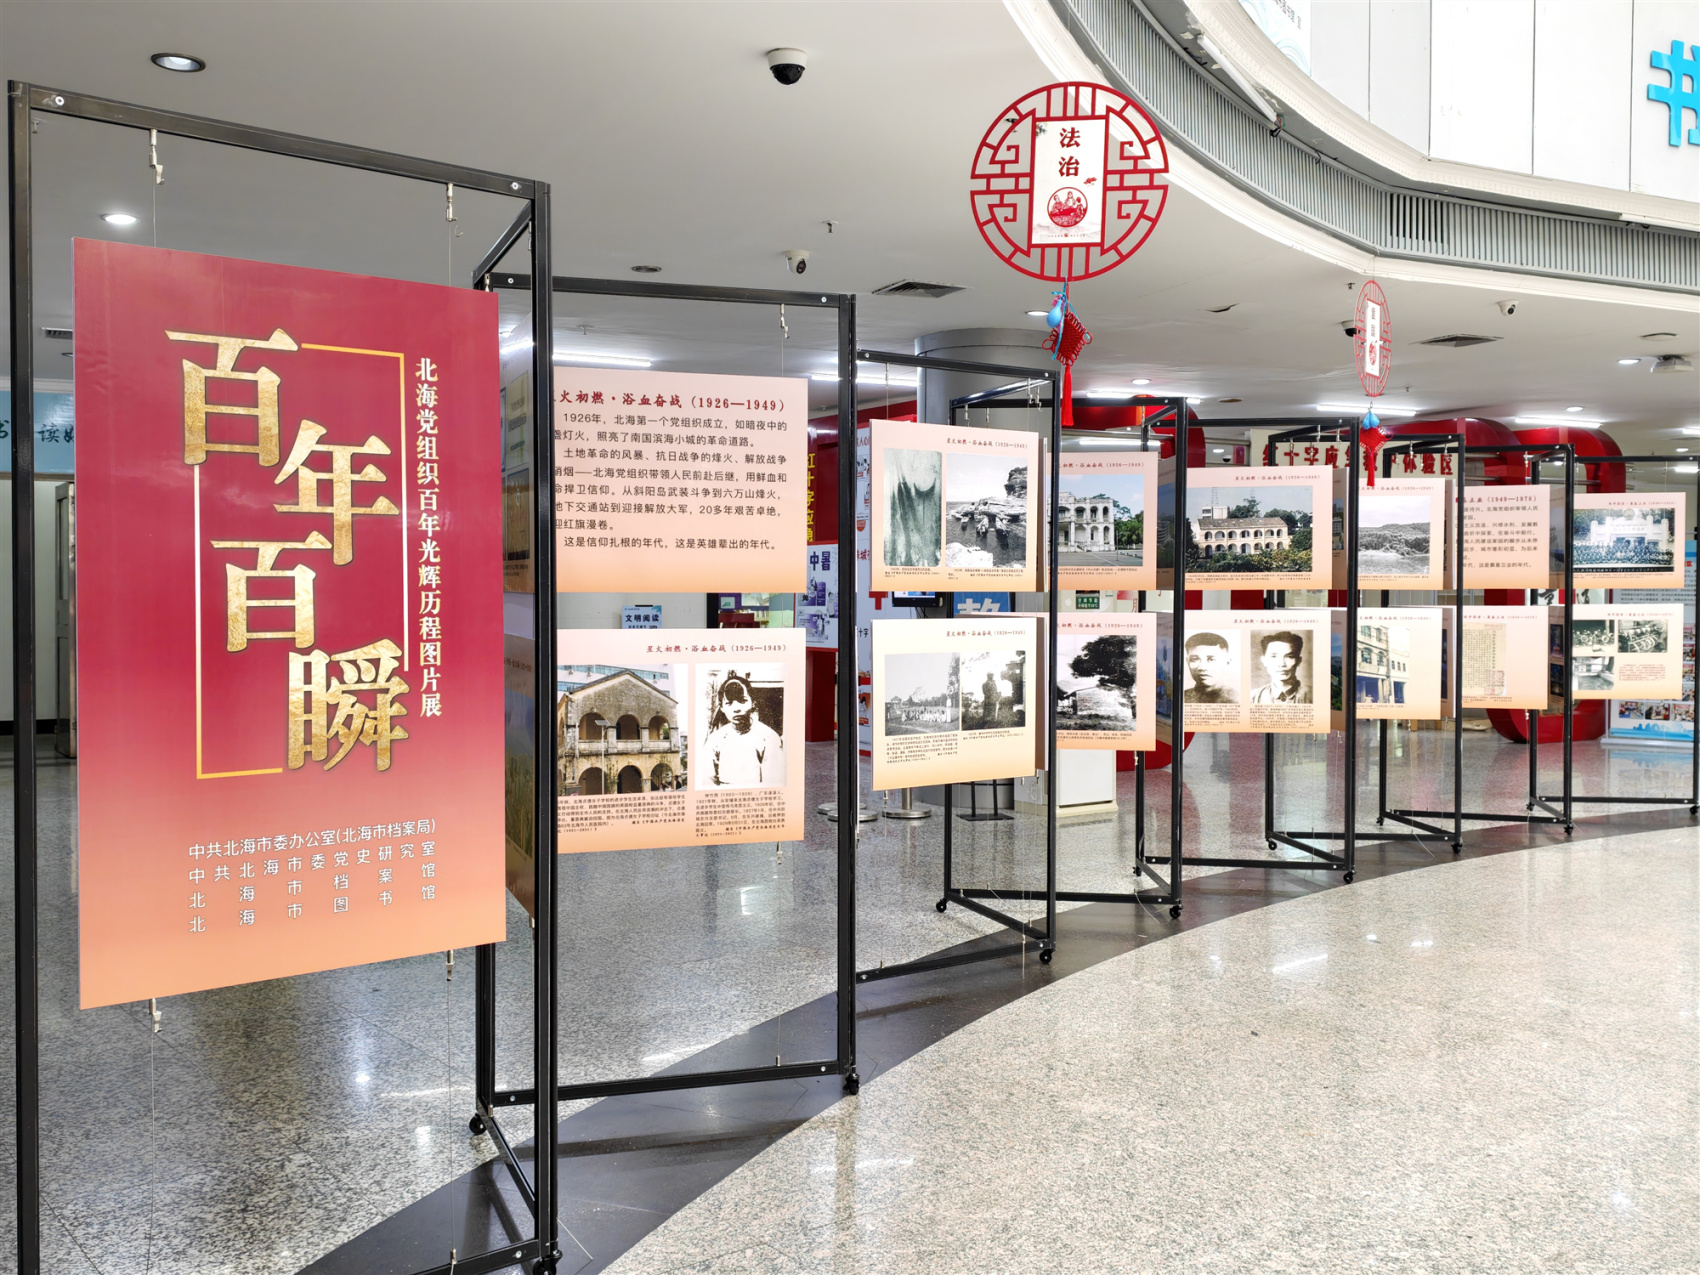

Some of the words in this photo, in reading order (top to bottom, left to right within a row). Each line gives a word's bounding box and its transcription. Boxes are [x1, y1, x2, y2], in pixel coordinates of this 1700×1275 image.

[1058, 127, 1081, 177] 法治
[554, 390, 785, 412] 火初燃·浴血奋战（1926—1949）
[415, 357, 442, 717] 北海党组织百年光辉历程图片展
[810, 551, 831, 572] 中暑
[625, 613, 660, 623] 文明阅读
[188, 817, 436, 860] 中共北海市委办公室(北海市档案局)
[188, 841, 436, 885] 中共北海市委党史研究室
